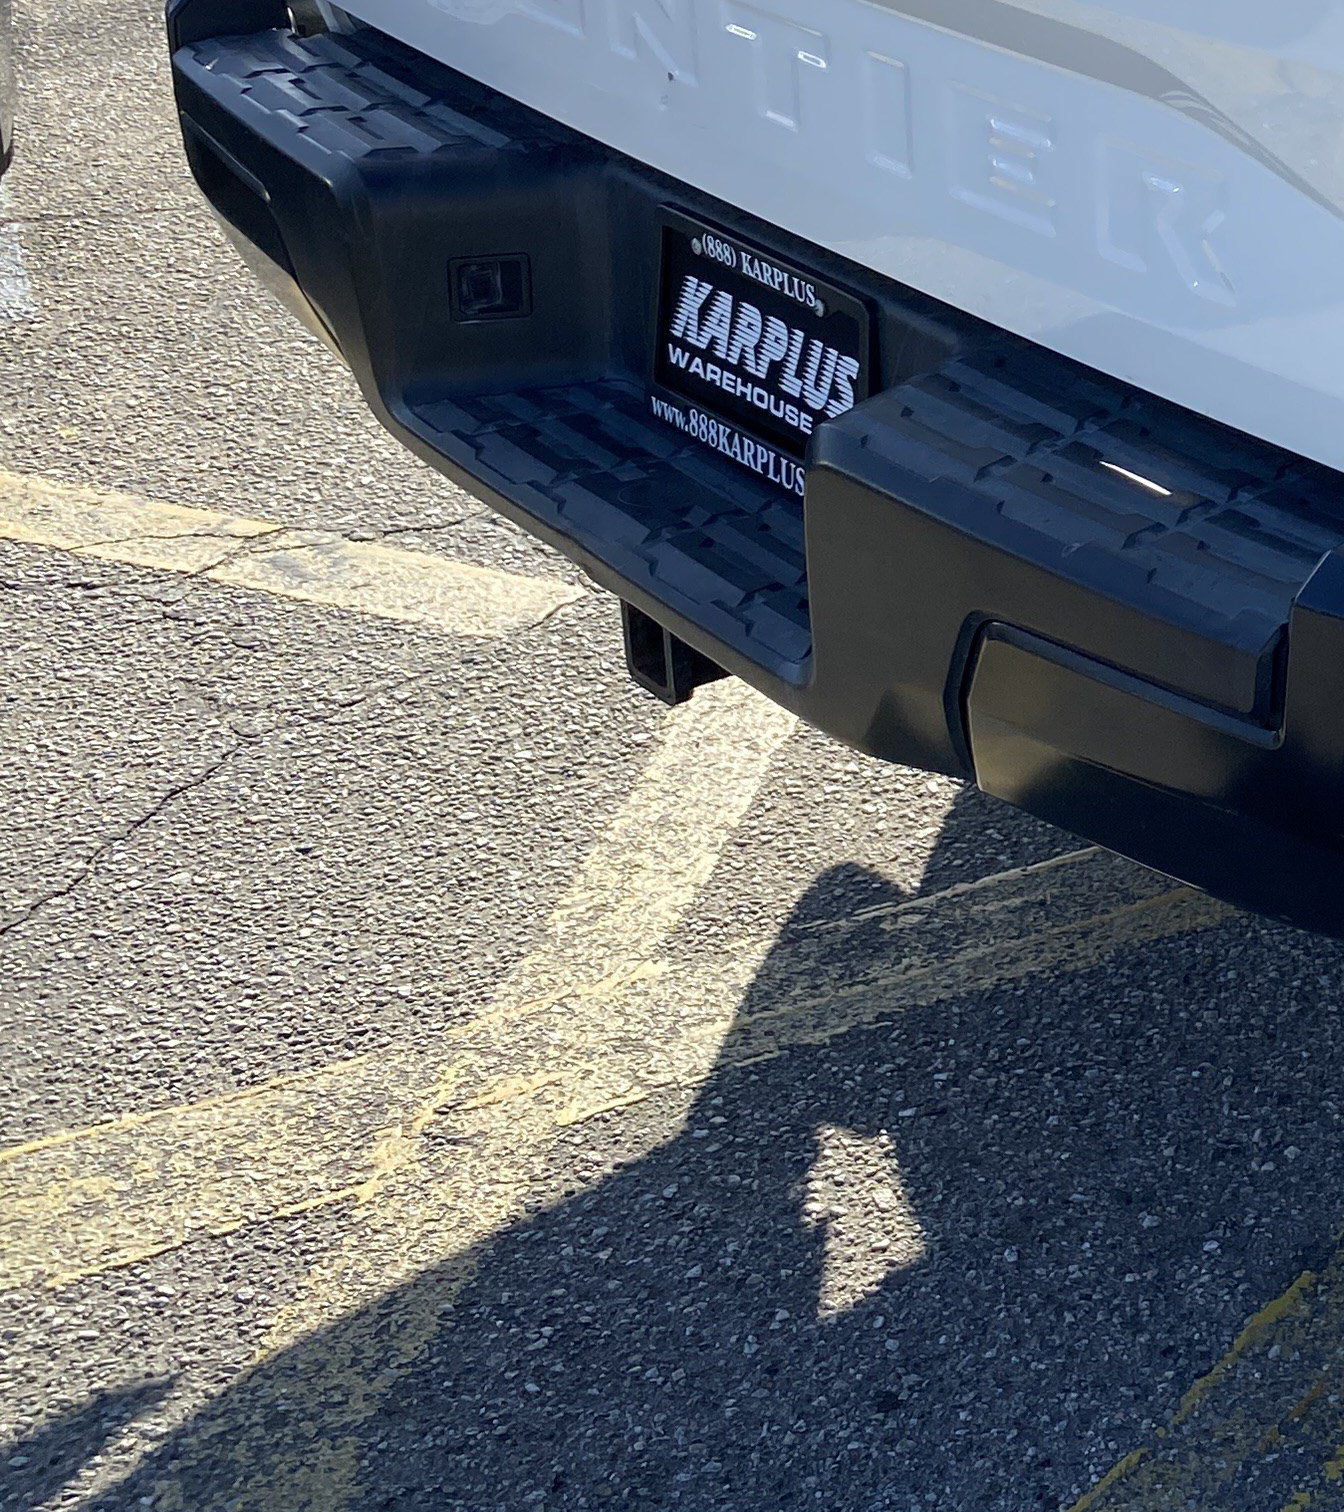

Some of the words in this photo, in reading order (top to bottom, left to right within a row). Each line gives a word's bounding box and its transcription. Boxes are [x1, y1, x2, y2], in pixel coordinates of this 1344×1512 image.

[701, 232, 737, 269] (888)
[741, 252, 816, 308] KARPLUS
[667, 342, 814, 436] WAREHOUSE
[669, 274, 860, 420] KARPLUS
